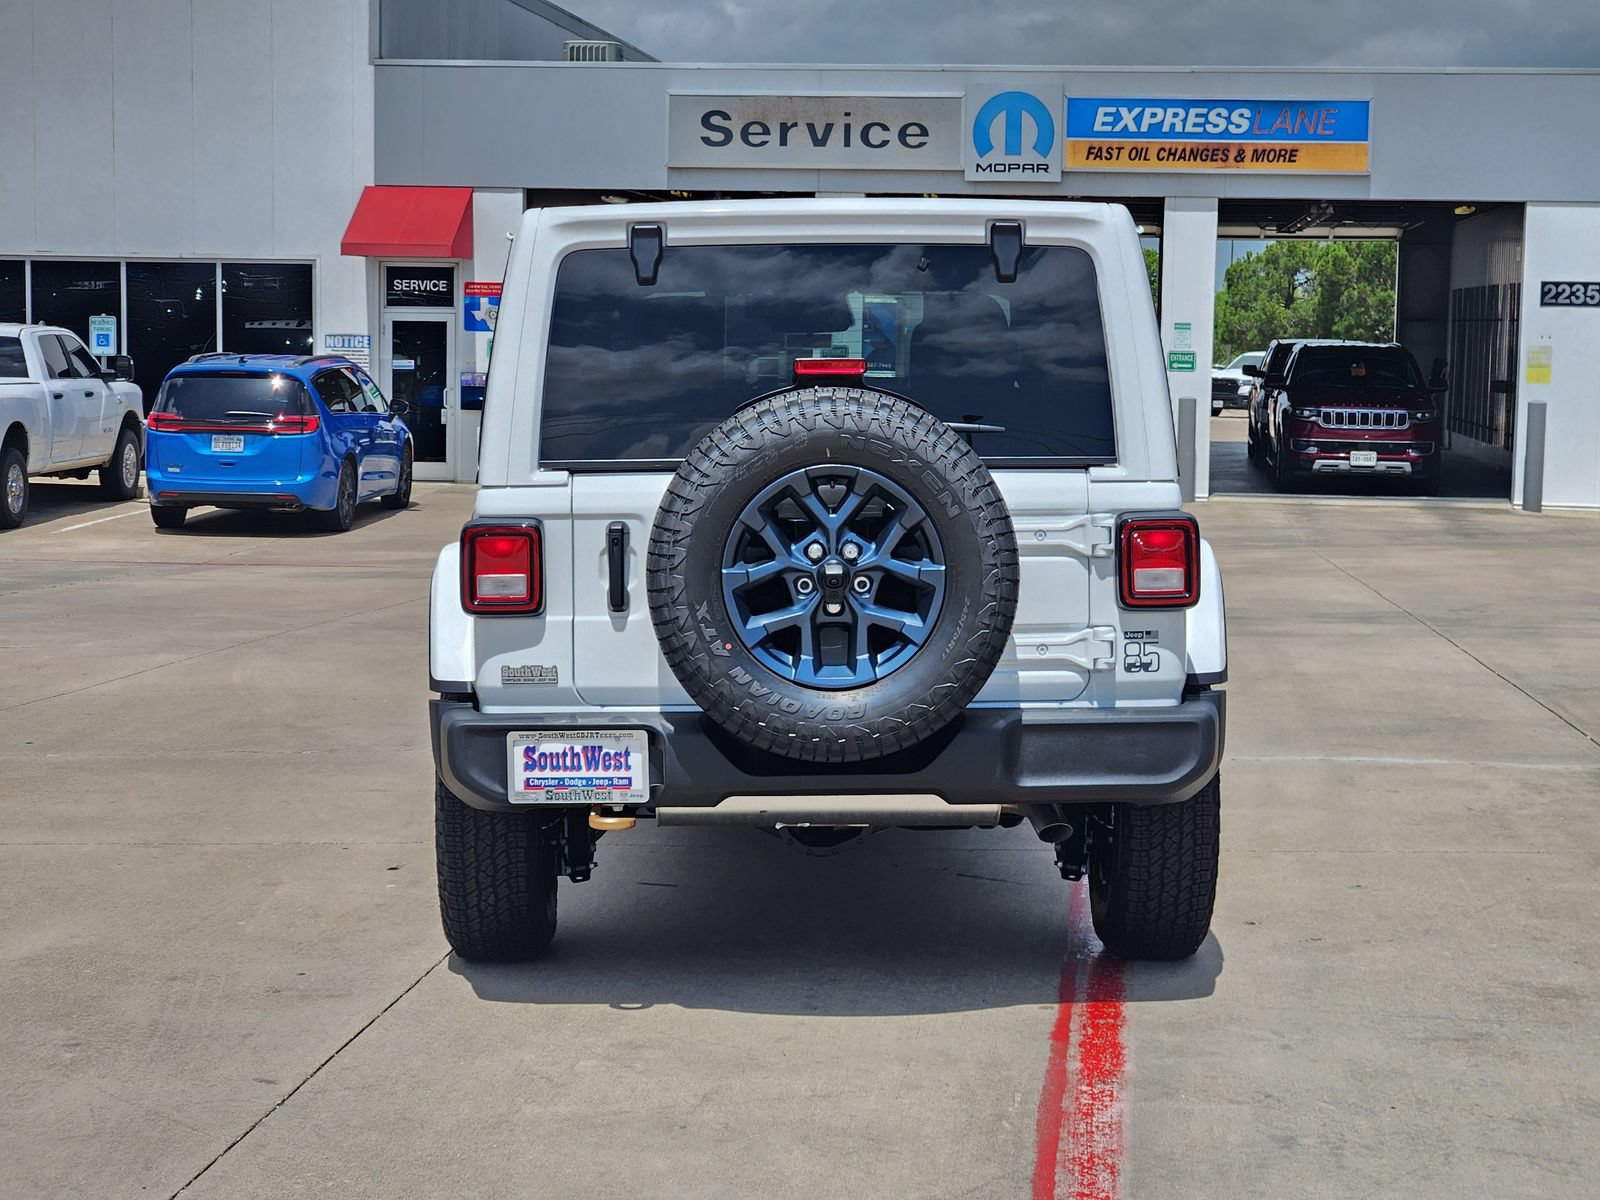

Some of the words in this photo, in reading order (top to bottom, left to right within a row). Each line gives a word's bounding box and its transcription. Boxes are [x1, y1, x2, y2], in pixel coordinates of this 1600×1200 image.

[700, 109, 930, 149] Service
[1086, 146, 1124, 161] FAST
[1128, 146, 1150, 162] OIL
[1156, 147, 1229, 163] CHANGES
[1234, 148, 1246, 163] &
[1251, 148, 1298, 164] MORE
[975, 163, 1050, 174] MOPAR
[393, 279, 448, 292] SERVICE
[1543, 283, 1600, 305] 2235
[325, 335, 370, 348] NOTICE
[1170, 354, 1194, 362] ENTRANCE
[1125, 631, 1143, 639] Jeep
[1124, 641, 1160, 672] 85
[501, 664, 558, 677] SouthWest
[728, 666, 868, 721] ROADIAN
[523, 745, 632, 773] SouthWest
[529, 778, 559, 787] Chrysler
[564, 778, 587, 787] Dodge
[592, 778, 609, 787] Jeep
[545, 789, 614, 801] SouthWest
